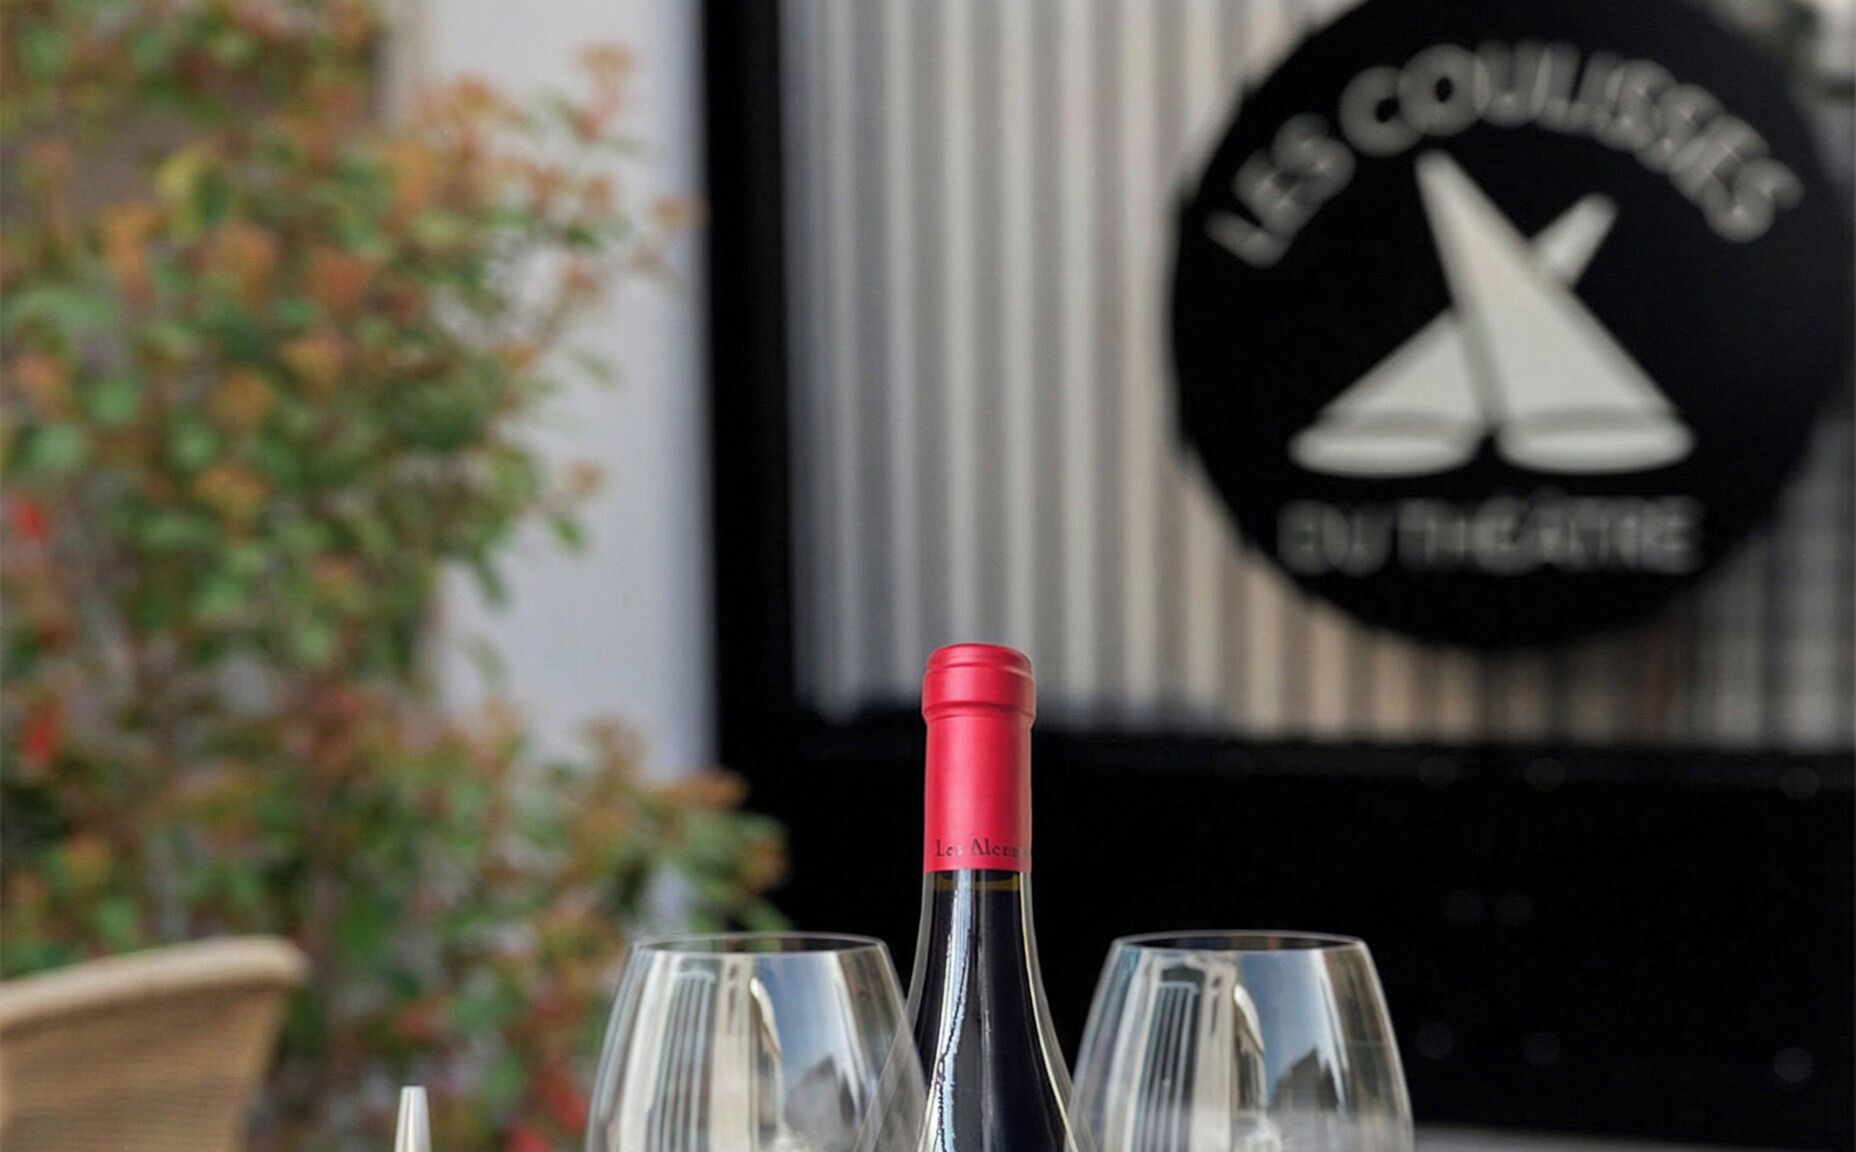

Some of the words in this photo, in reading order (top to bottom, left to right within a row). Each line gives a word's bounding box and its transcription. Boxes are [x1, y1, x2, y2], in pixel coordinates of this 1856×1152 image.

[1204, 113, 1356, 270] LES
[1276, 499, 1393, 577] DU
[935, 839, 964, 857] Le
